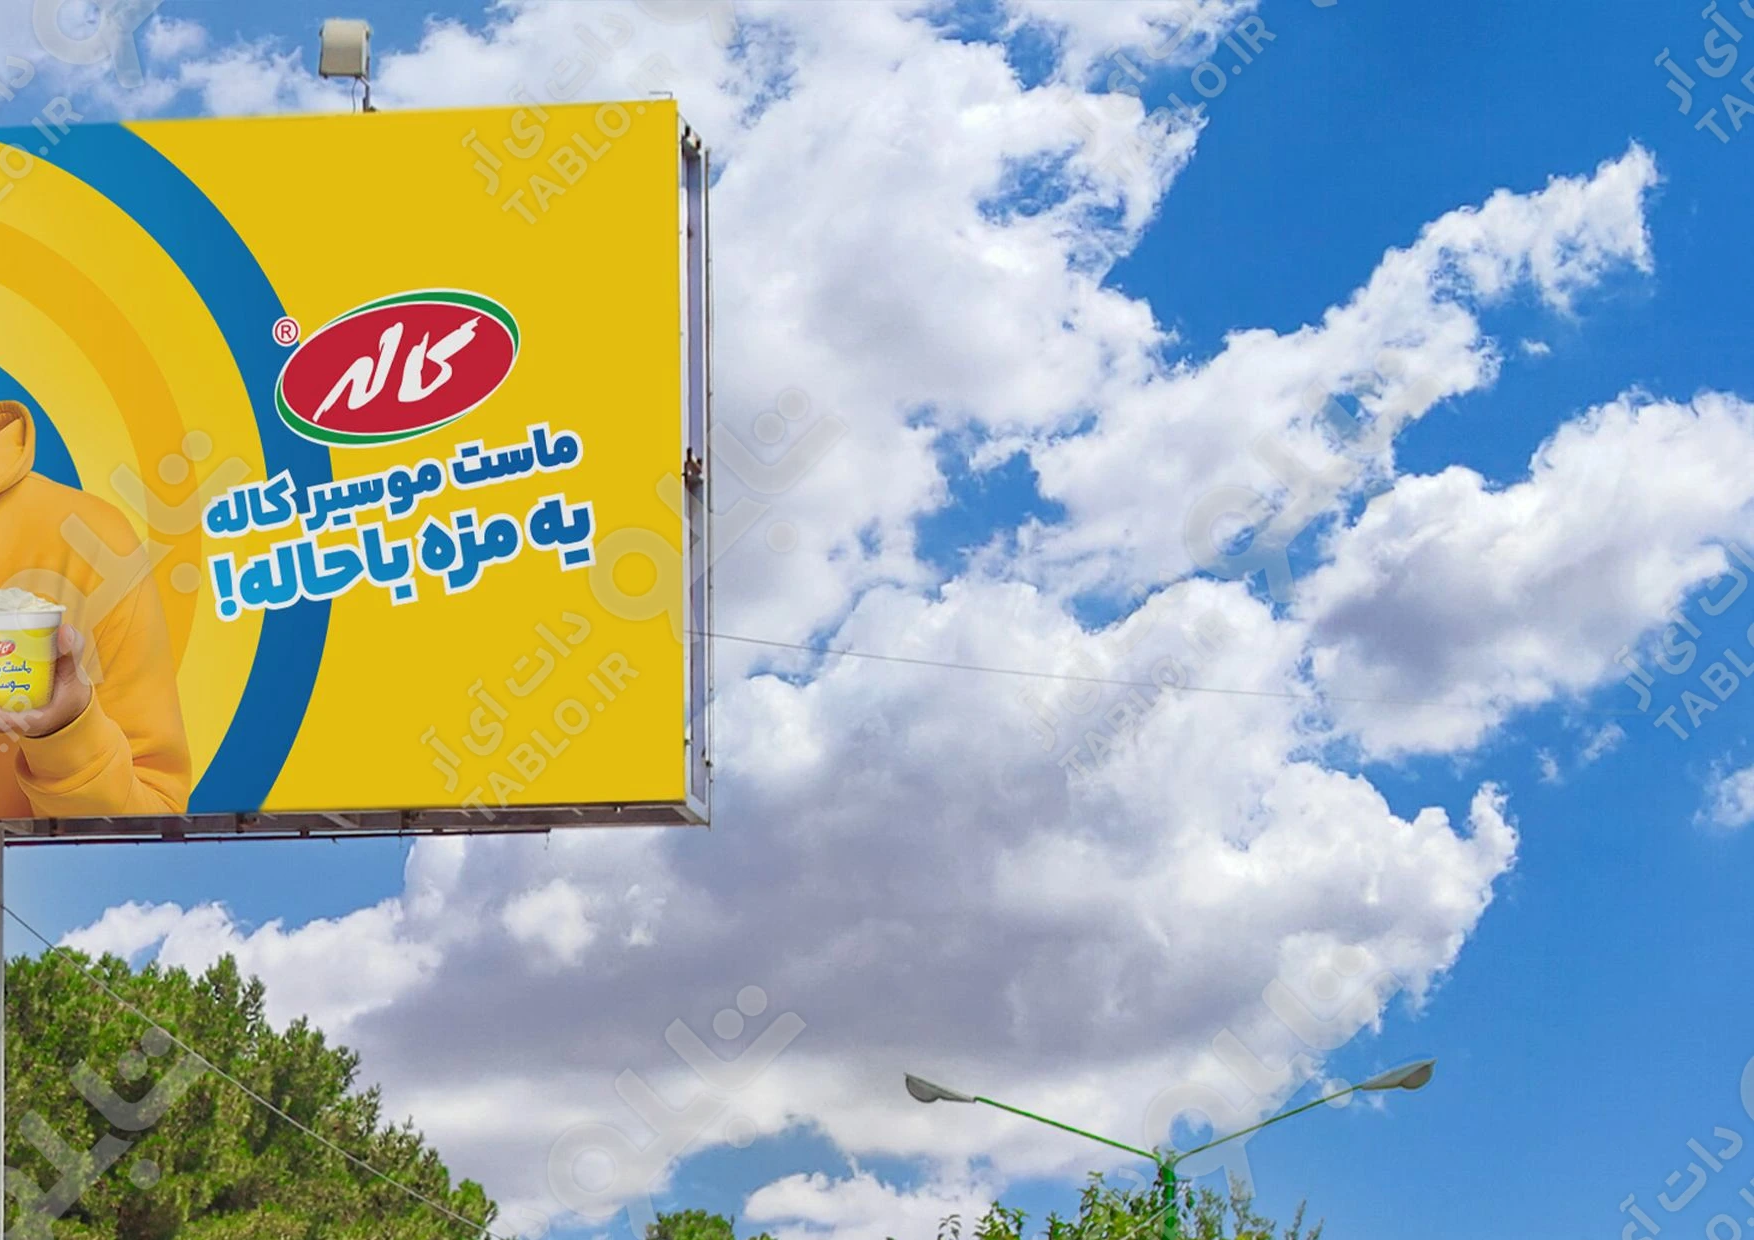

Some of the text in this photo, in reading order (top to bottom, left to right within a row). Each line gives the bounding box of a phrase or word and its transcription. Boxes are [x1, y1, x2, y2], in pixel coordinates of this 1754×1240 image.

[205, 427, 580, 534] ماست موسیر کاله
[420, 510, 519, 590] مزه
[529, 498, 592, 565] یه
